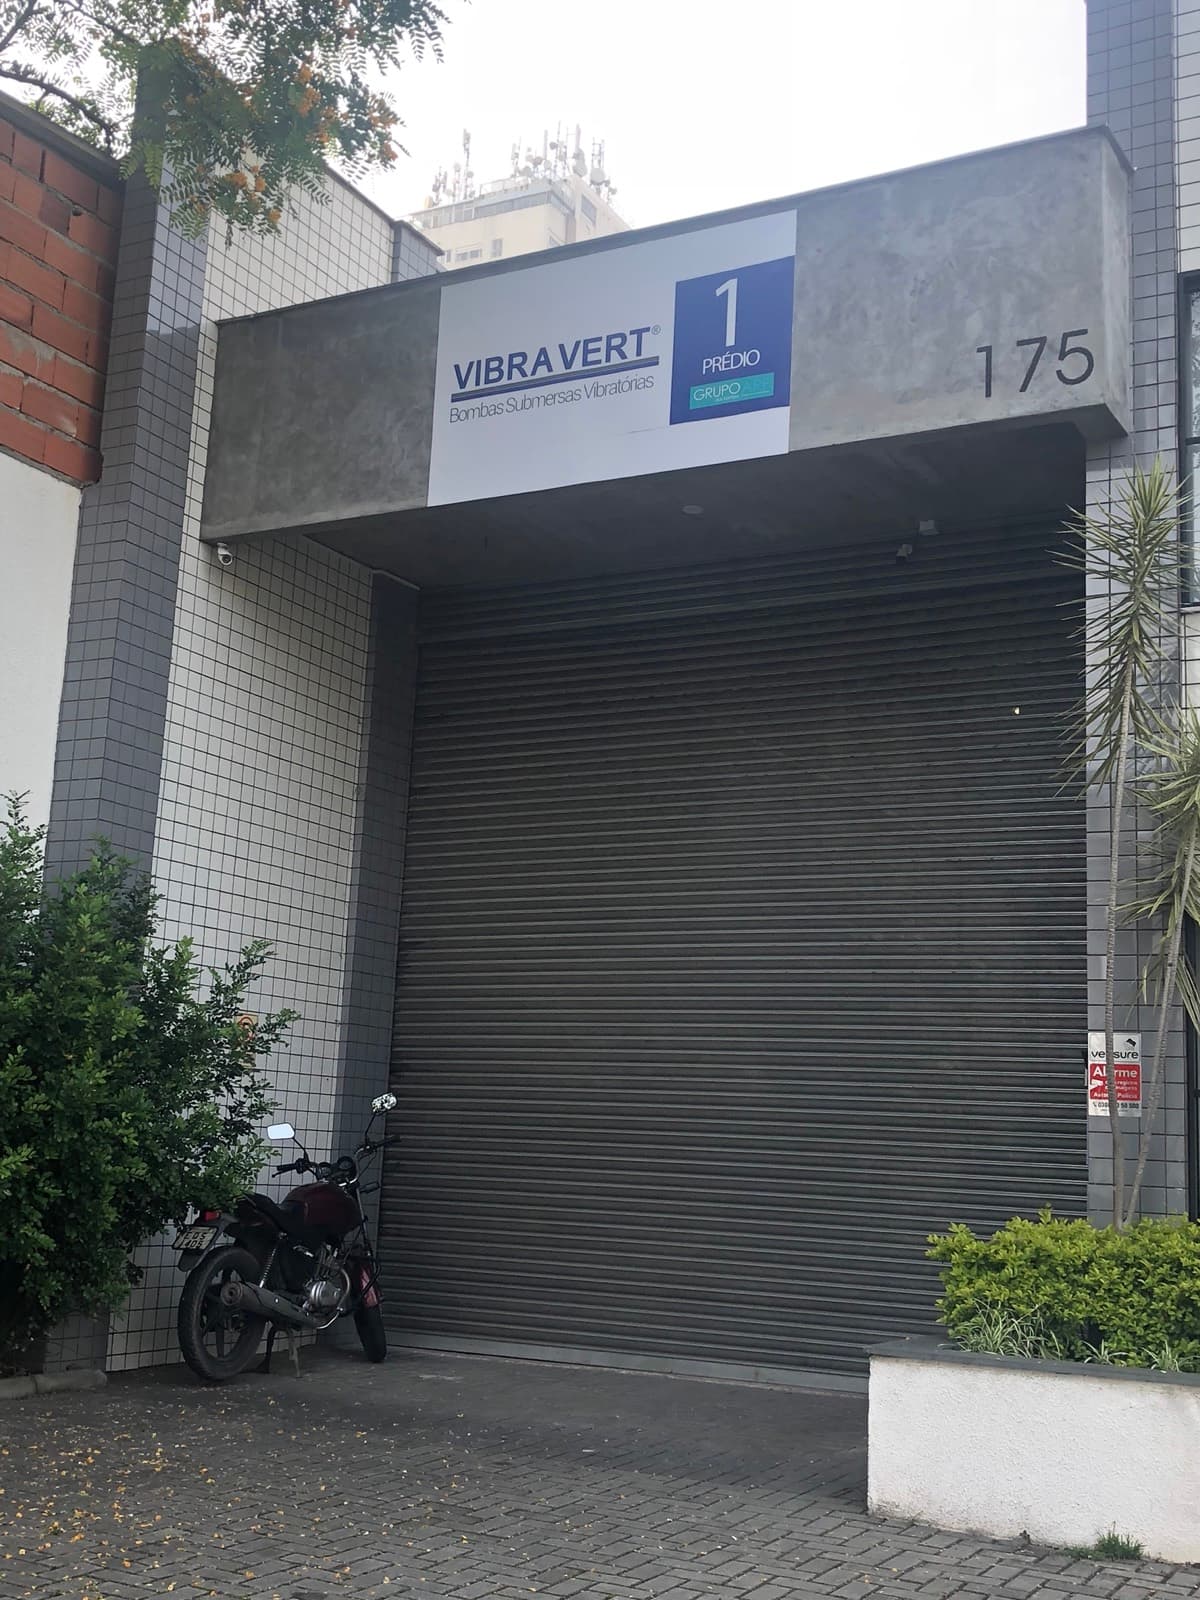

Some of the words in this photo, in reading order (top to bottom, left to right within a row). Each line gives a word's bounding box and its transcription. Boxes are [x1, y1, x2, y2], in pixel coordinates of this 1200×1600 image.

[715, 277, 738, 347] 1
[702, 348, 761, 375] PRÉDIO
[976, 328, 1095, 398] 175
[449, 401, 504, 424] Bombas
[505, 388, 582, 413] Submersas
[583, 374, 655, 400] Vibratórias
[693, 382, 741, 401] GRUPO
[1091, 1050, 1139, 1059] vesure
[1092, 1065, 1138, 1078] Alrme
